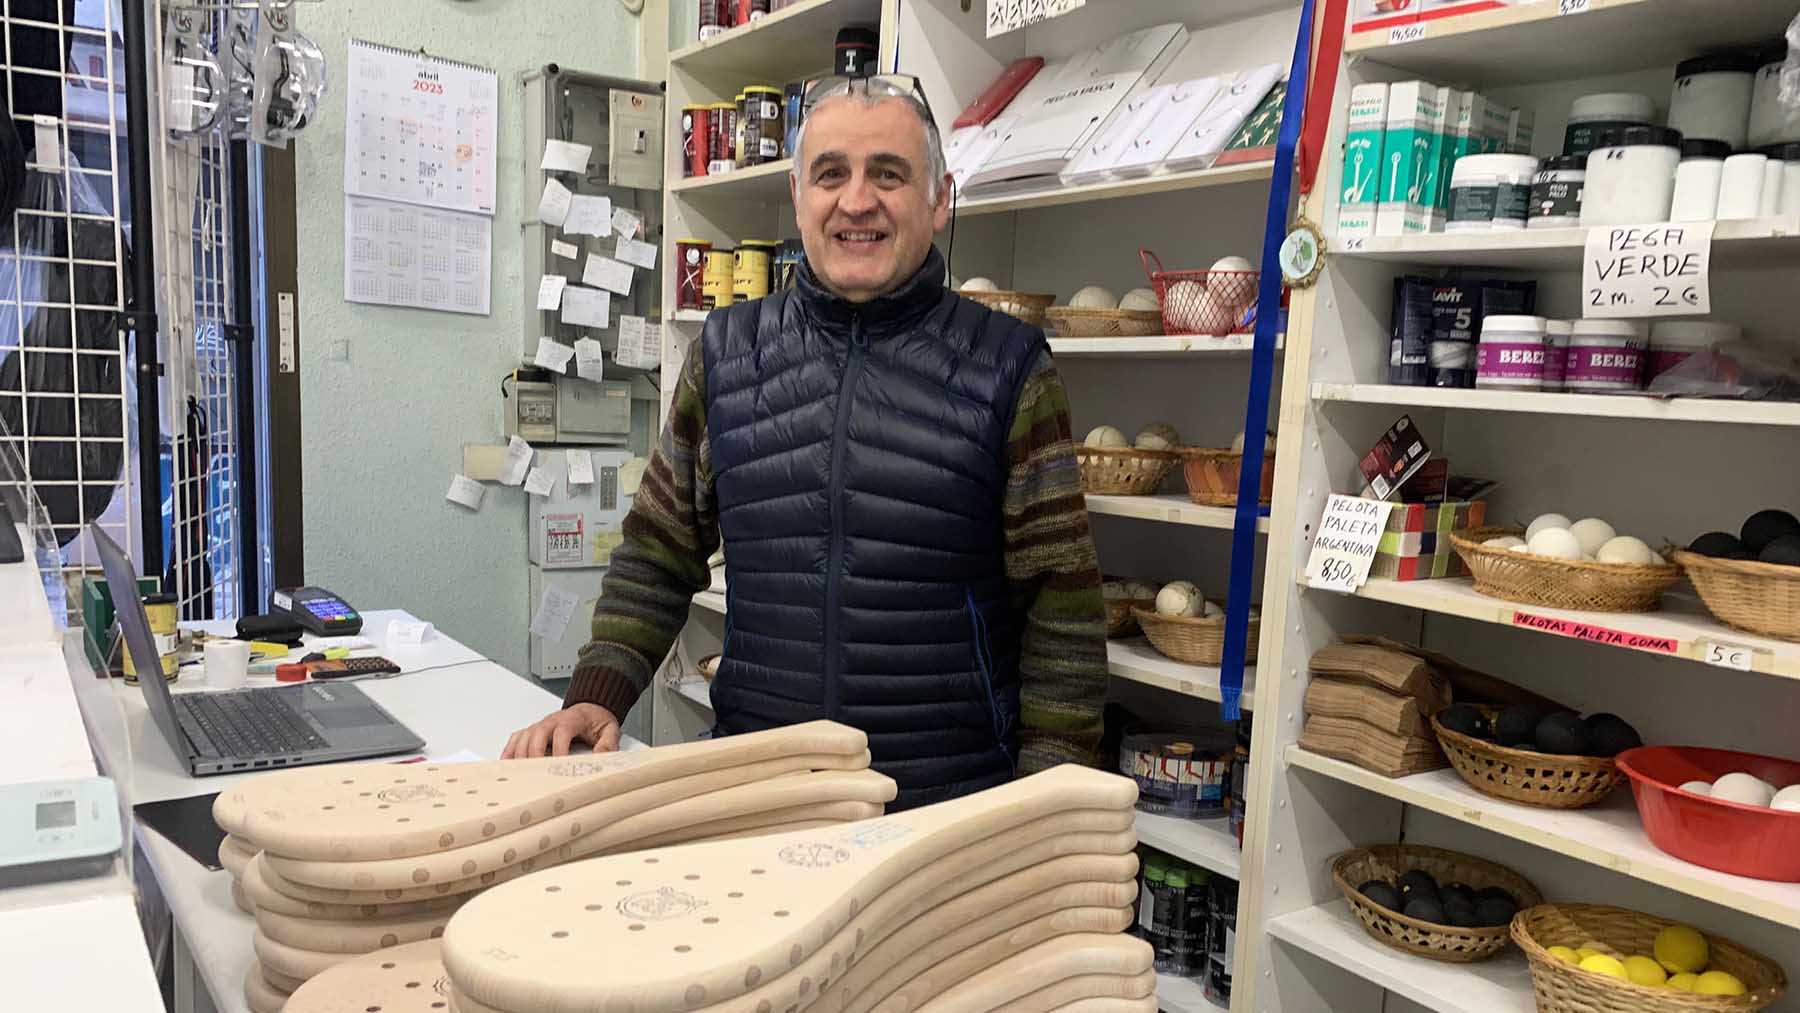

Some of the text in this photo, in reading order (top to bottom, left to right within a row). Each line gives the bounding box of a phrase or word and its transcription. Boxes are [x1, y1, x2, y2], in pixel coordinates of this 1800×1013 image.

[417, 69, 439, 82] abril
[412, 79, 444, 95] 2023
[1550, 183, 1569, 192] PEGA
[1609, 228, 1684, 251] PEGA
[1595, 253, 1699, 281] VERDE
[1454, 307, 1472, 330] 5
[1499, 349, 1545, 365] BEREZ
[1589, 352, 1639, 369] BEREZ
[1331, 500, 1378, 518] PELOTA
[1323, 516, 1378, 537] PALETA
[1314, 536, 1374, 559] ARGENTINA
[1516, 612, 1671, 651] PELOTAS PALETA GOMA
